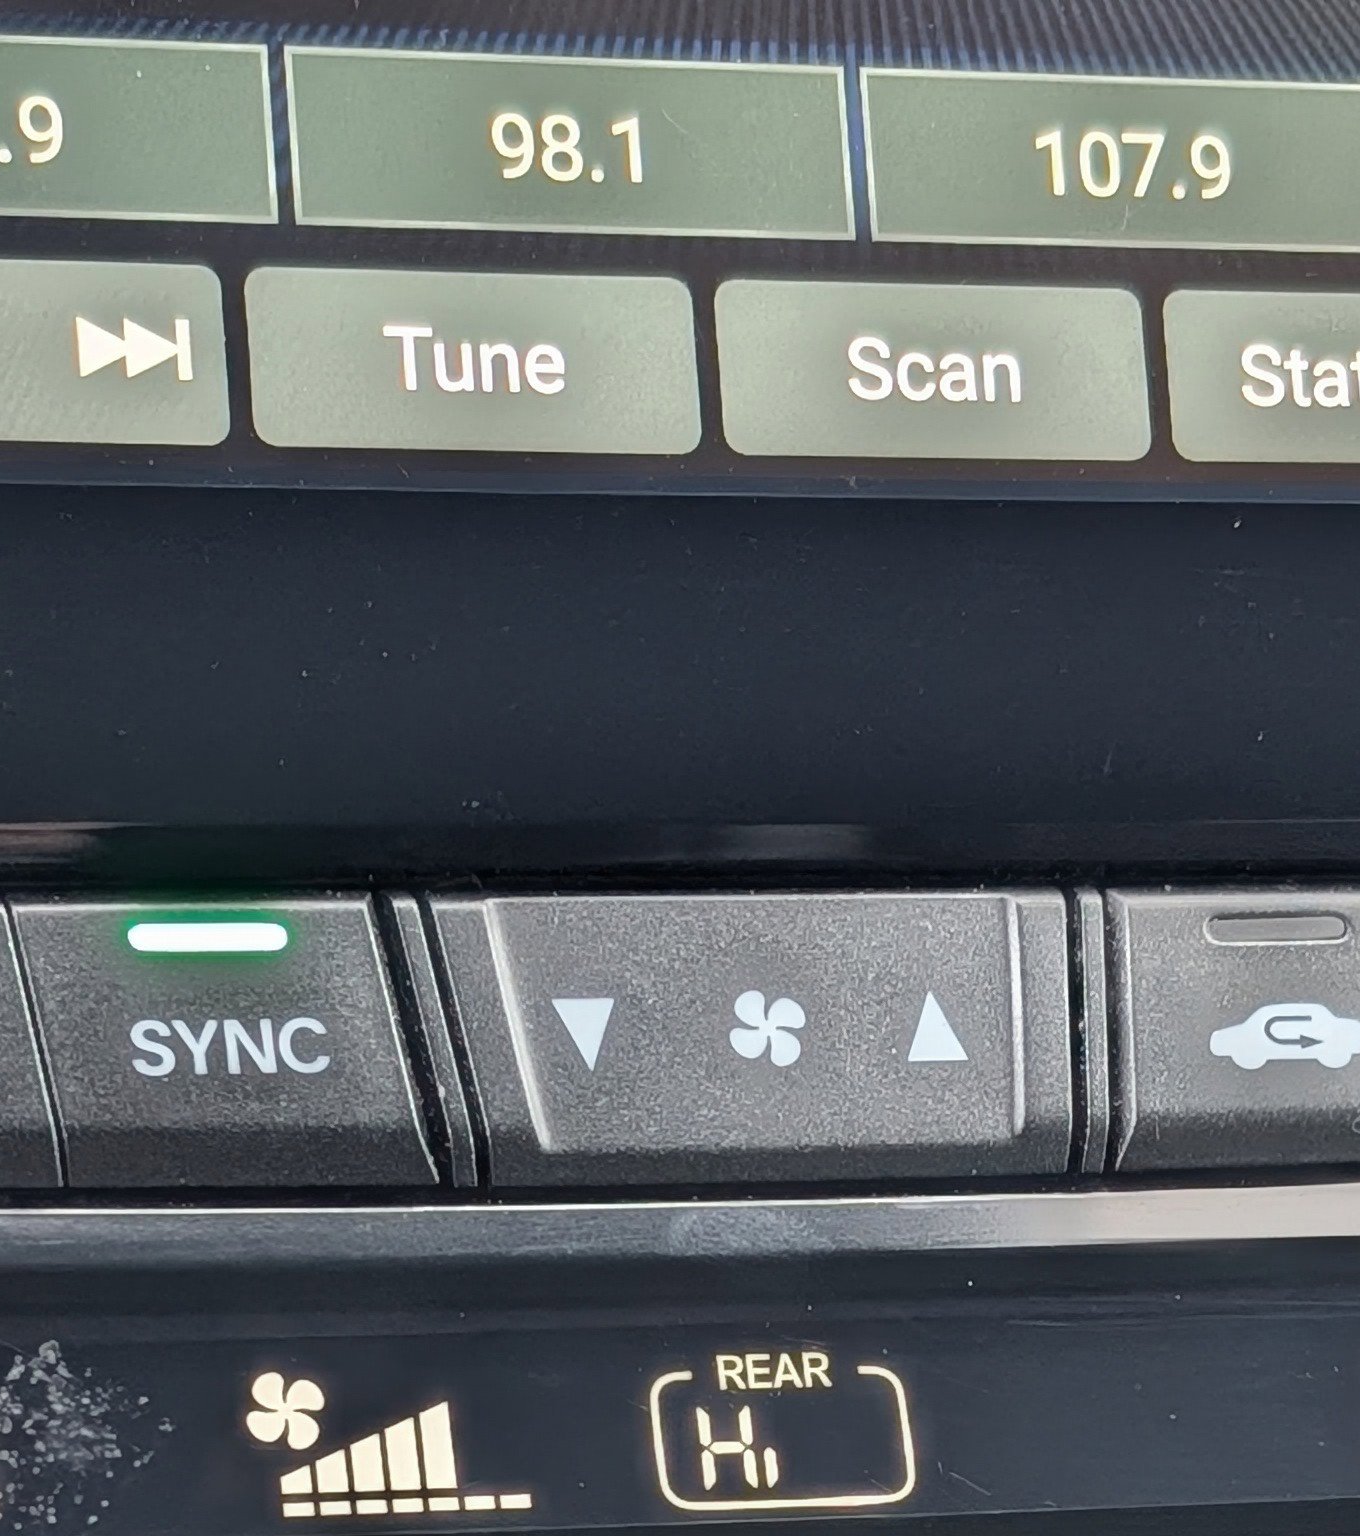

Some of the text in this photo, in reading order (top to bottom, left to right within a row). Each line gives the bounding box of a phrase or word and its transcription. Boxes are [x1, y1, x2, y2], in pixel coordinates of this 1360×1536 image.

[489, 112, 646, 184] 98.1
[1033, 127, 1233, 199] 107.9
[383, 323, 566, 395] Tune
[847, 337, 1023, 406] Scan
[130, 1016, 331, 1075] SYNC
[716, 1352, 832, 1391] REAR
